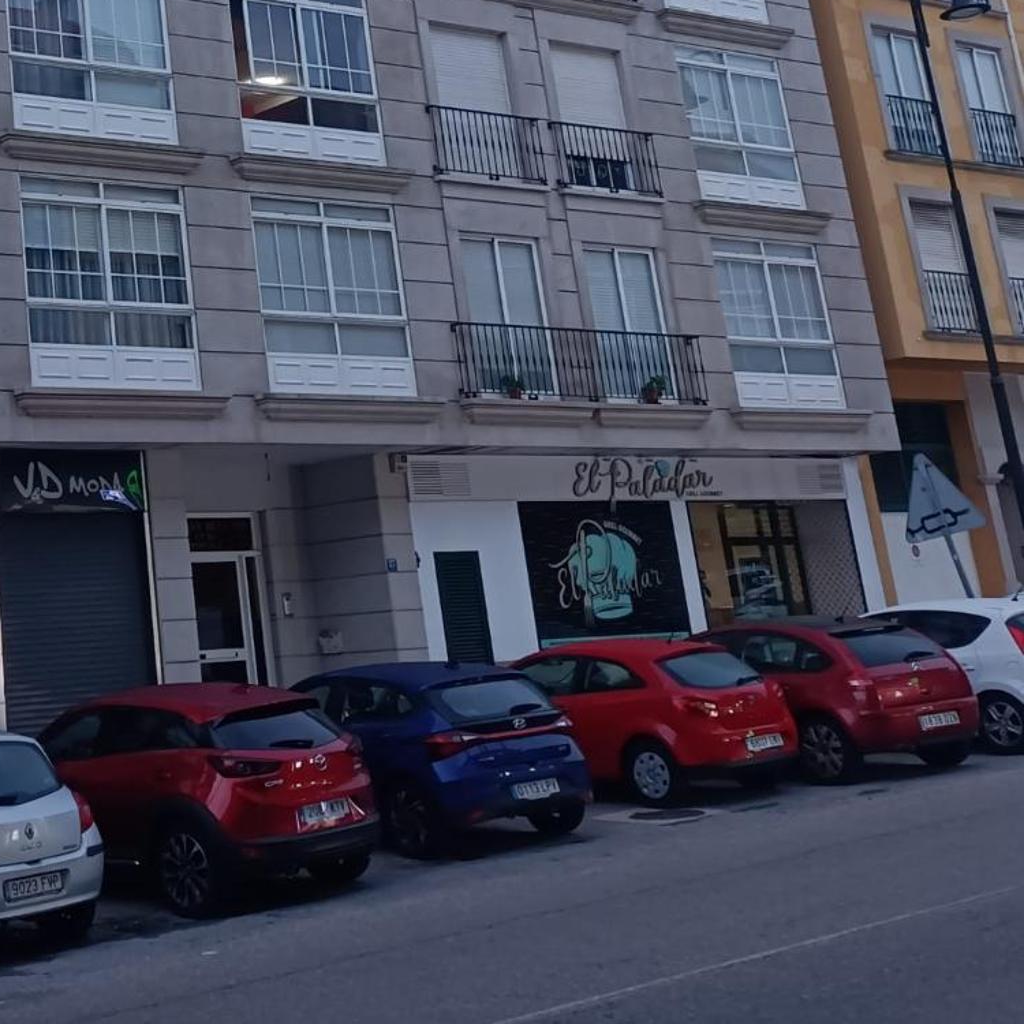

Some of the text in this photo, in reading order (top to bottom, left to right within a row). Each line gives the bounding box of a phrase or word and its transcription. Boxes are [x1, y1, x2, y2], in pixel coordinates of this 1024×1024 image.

[573, 458, 713, 498] El Paladar
[11, 878, 38, 897] 9023
